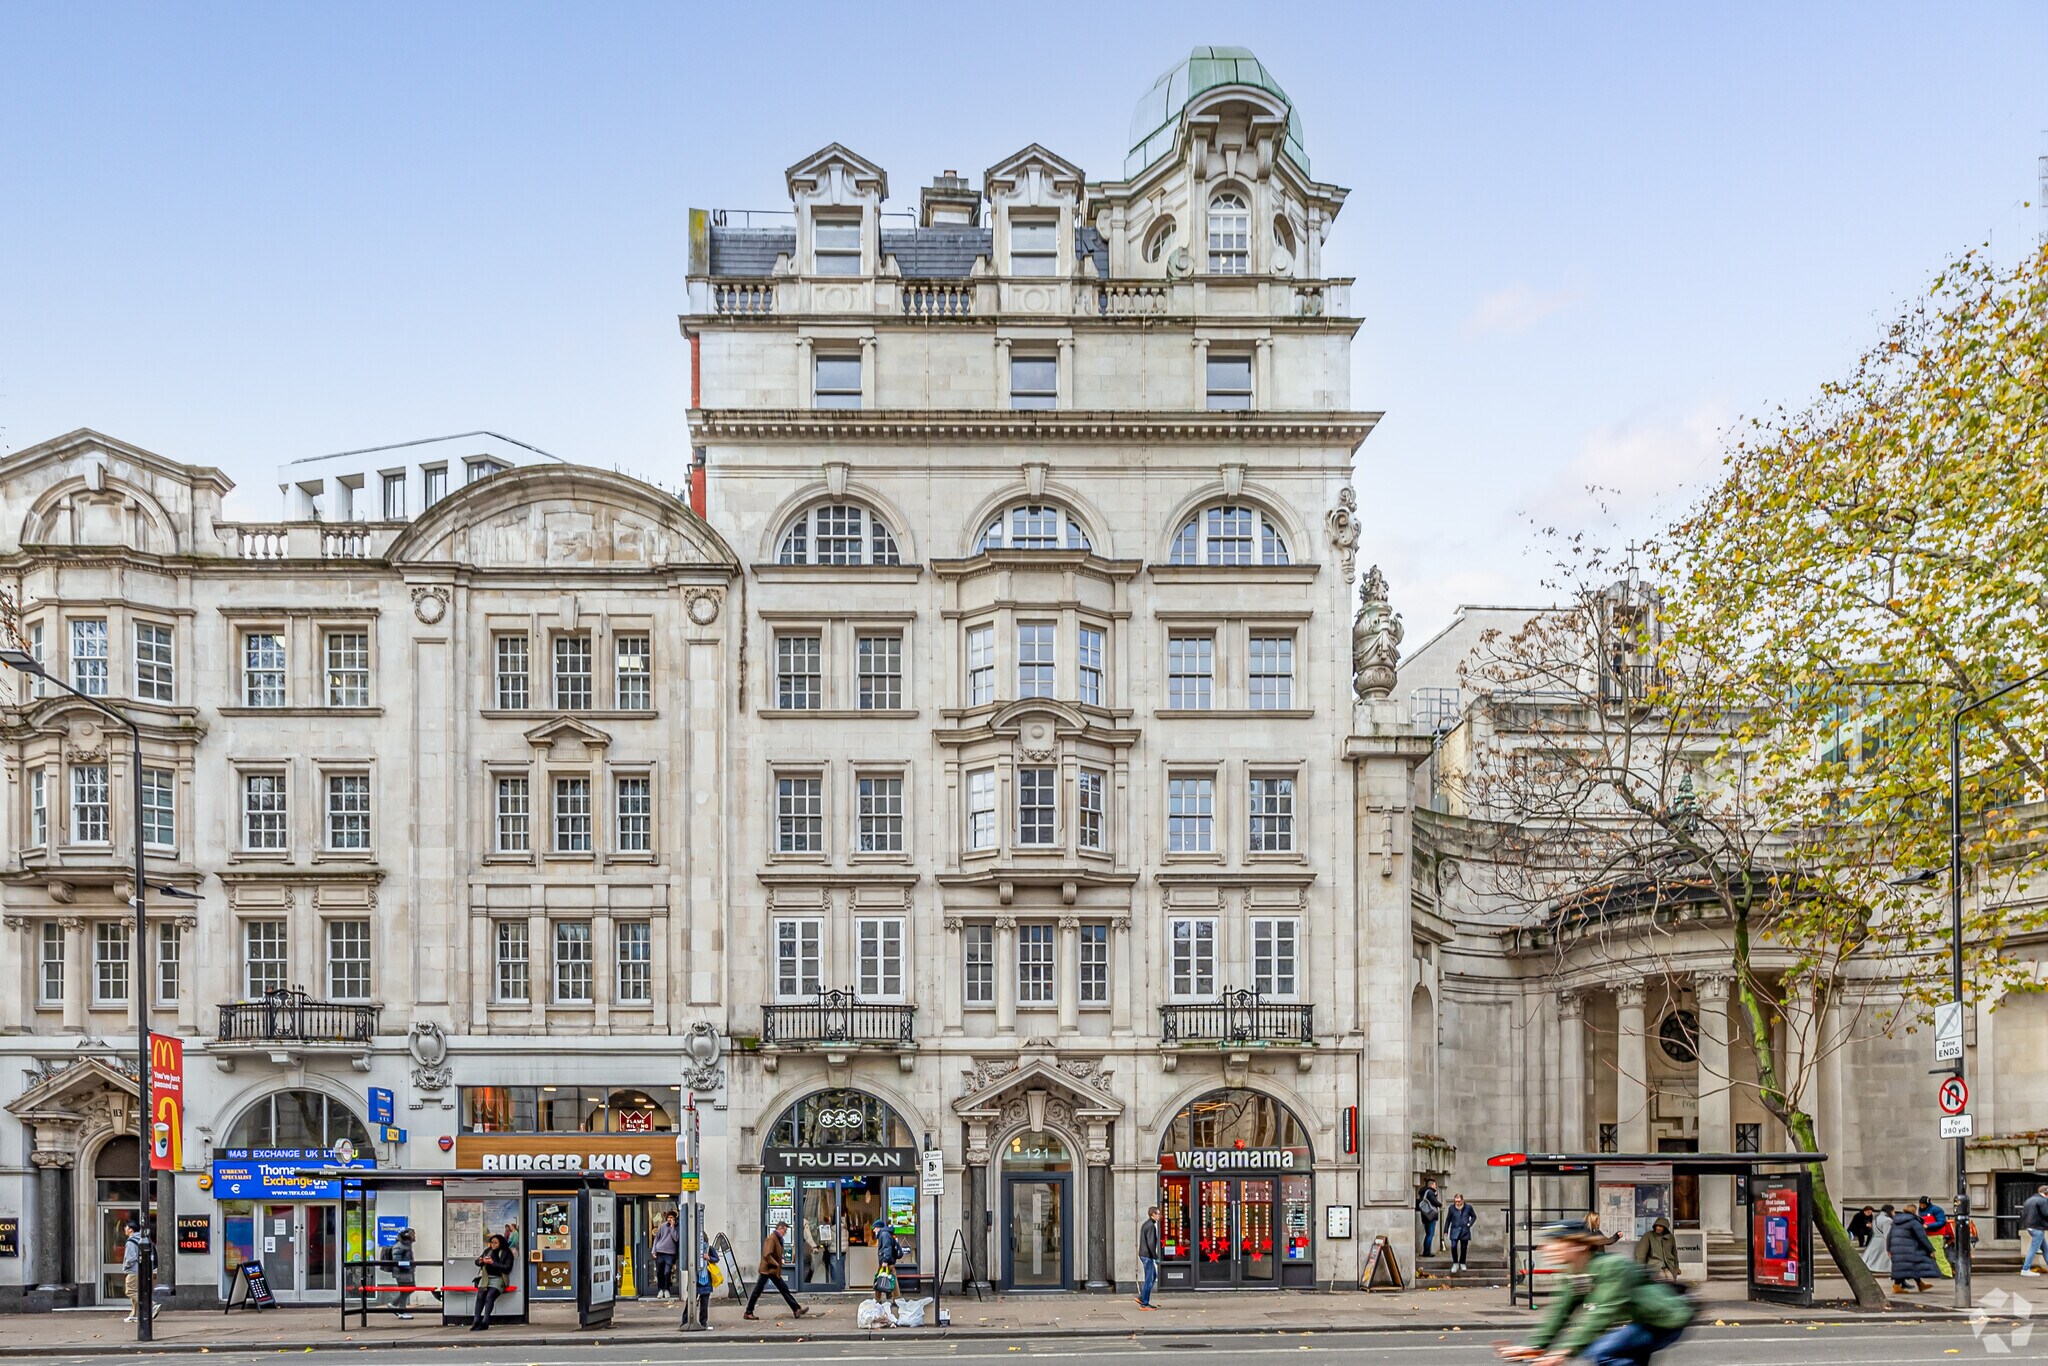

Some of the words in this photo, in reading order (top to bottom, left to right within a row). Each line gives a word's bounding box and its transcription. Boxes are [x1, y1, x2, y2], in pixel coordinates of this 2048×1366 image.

[1938, 1047, 1960, 1057] ENDS
[154, 1071, 171, 1080] You've
[170, 1073, 181, 1083] just
[154, 1081, 172, 1090] passed
[172, 1083, 179, 1091] us
[113, 1109, 123, 1118] 113
[1943, 1127, 1957, 1135] 380
[1958, 1126, 1970, 1135] yds
[253, 1150, 300, 1158] EXCHANGE
[306, 1150, 318, 1158] UK
[1025, 1147, 1049, 1159] 121
[482, 1154, 583, 1170] BURGER
[588, 1153, 652, 1176] KING
[779, 1152, 901, 1167] TRUEDAN
[1175, 1151, 1294, 1172] wagamama
[258, 1164, 301, 1175] Thoma
[263, 1175, 313, 1189] Exchange
[178, 1219, 209, 1228] BEACON
[188, 1231, 199, 1239] 113
[180, 1241, 207, 1249] HOUSE
